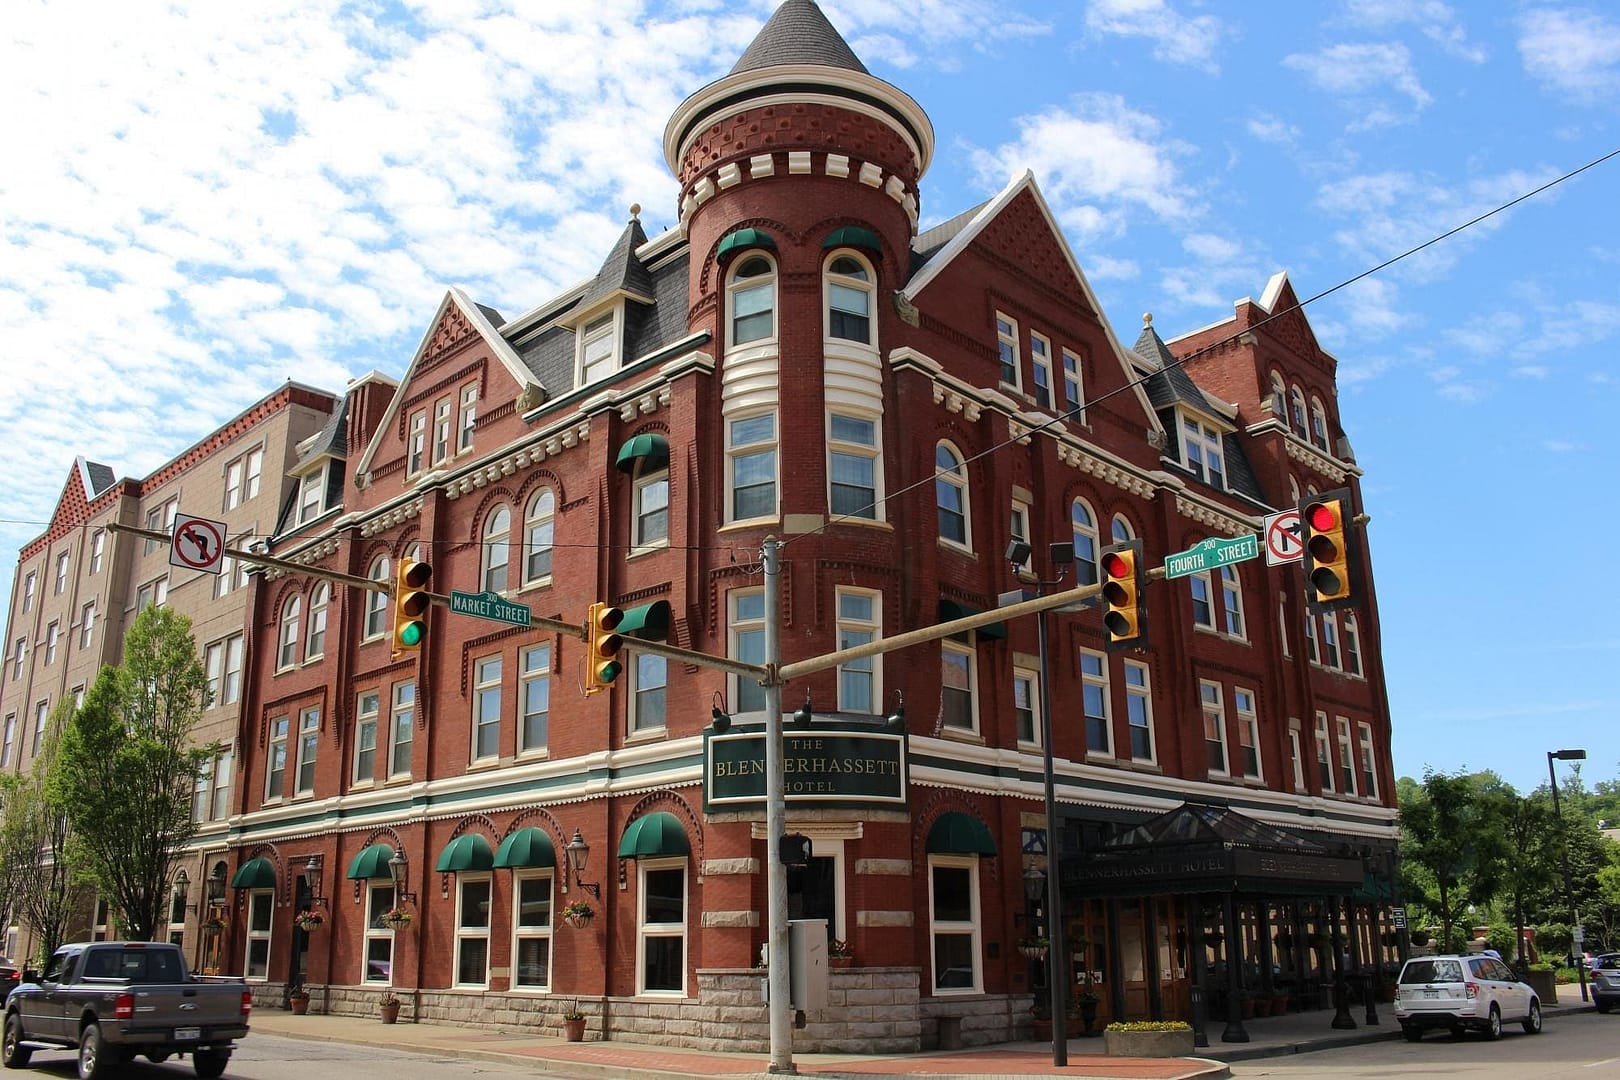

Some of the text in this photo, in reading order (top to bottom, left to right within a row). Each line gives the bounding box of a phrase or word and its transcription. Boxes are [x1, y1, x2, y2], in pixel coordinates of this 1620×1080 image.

[1204, 539, 1216, 550] 300
[1170, 541, 1252, 574] FOURTH STREET
[487, 593, 497, 602] 300
[454, 596, 528, 622] MARKET STREET
[792, 740, 823, 750] THE
[715, 758, 898, 777] BLENERHASSETT
